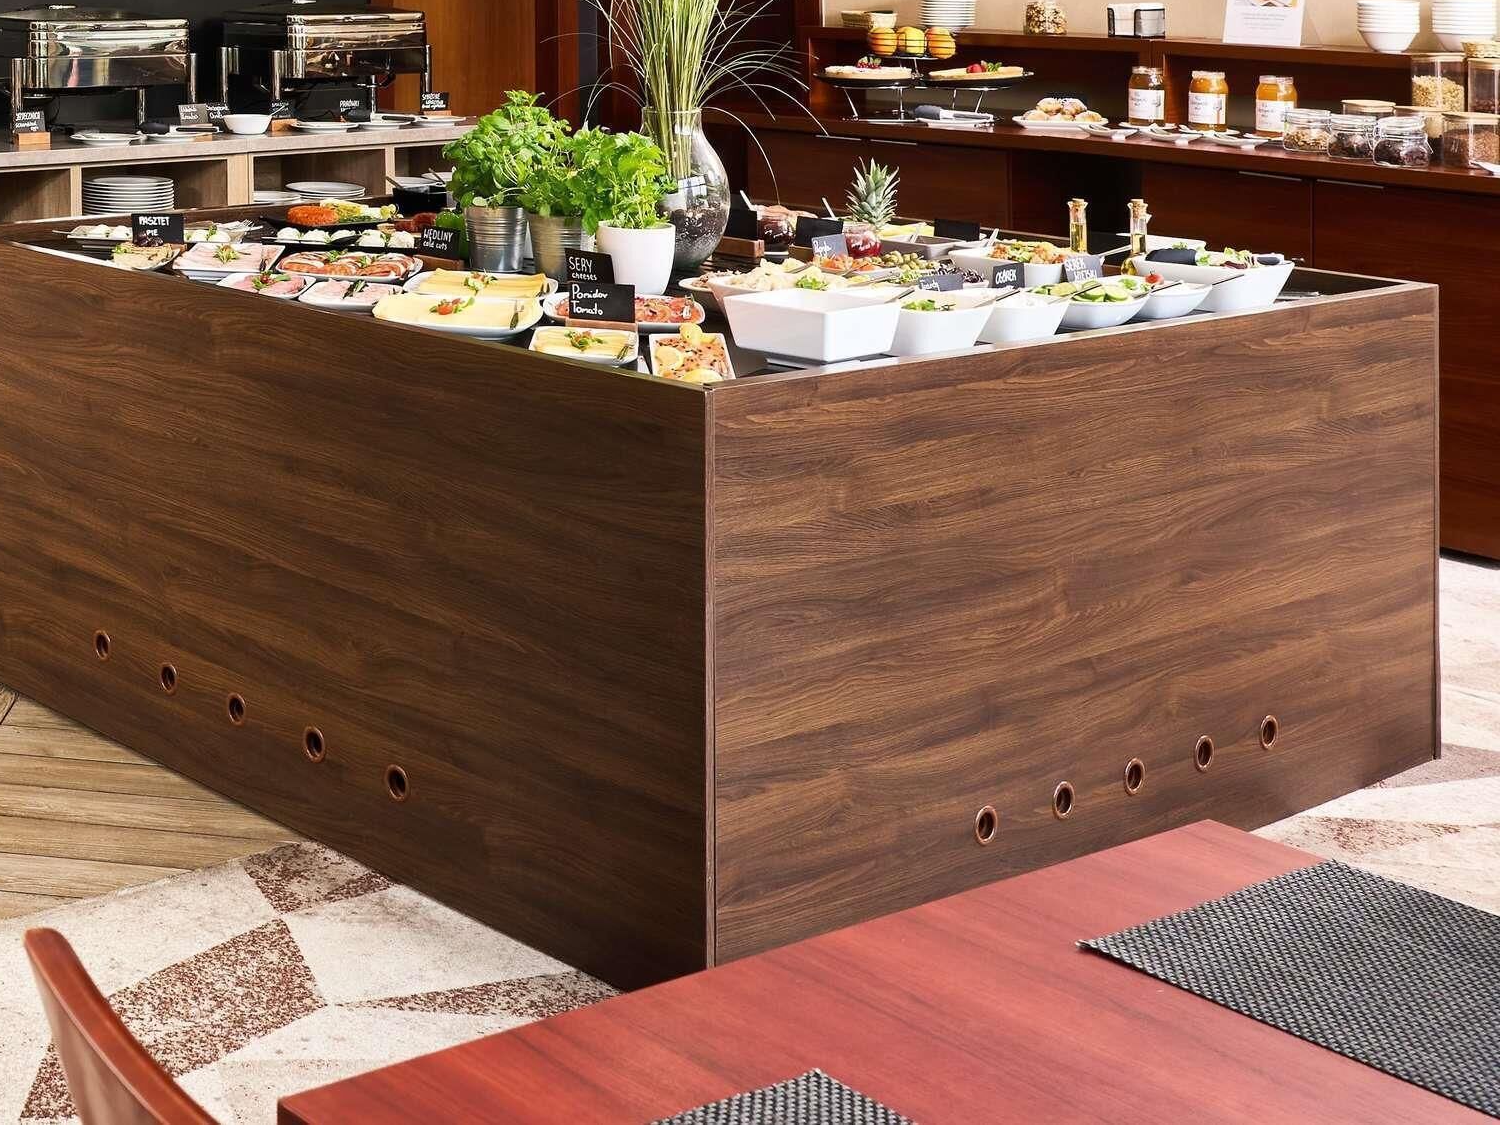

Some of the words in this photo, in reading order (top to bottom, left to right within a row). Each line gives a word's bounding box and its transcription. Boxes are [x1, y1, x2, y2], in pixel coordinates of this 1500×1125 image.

[138, 216, 170, 226] PASZTET
[568, 256, 593, 273] SERY
[571, 272, 598, 281] cheeses
[572, 283, 608, 299] Pomidor
[570, 300, 604, 316] Tomato
